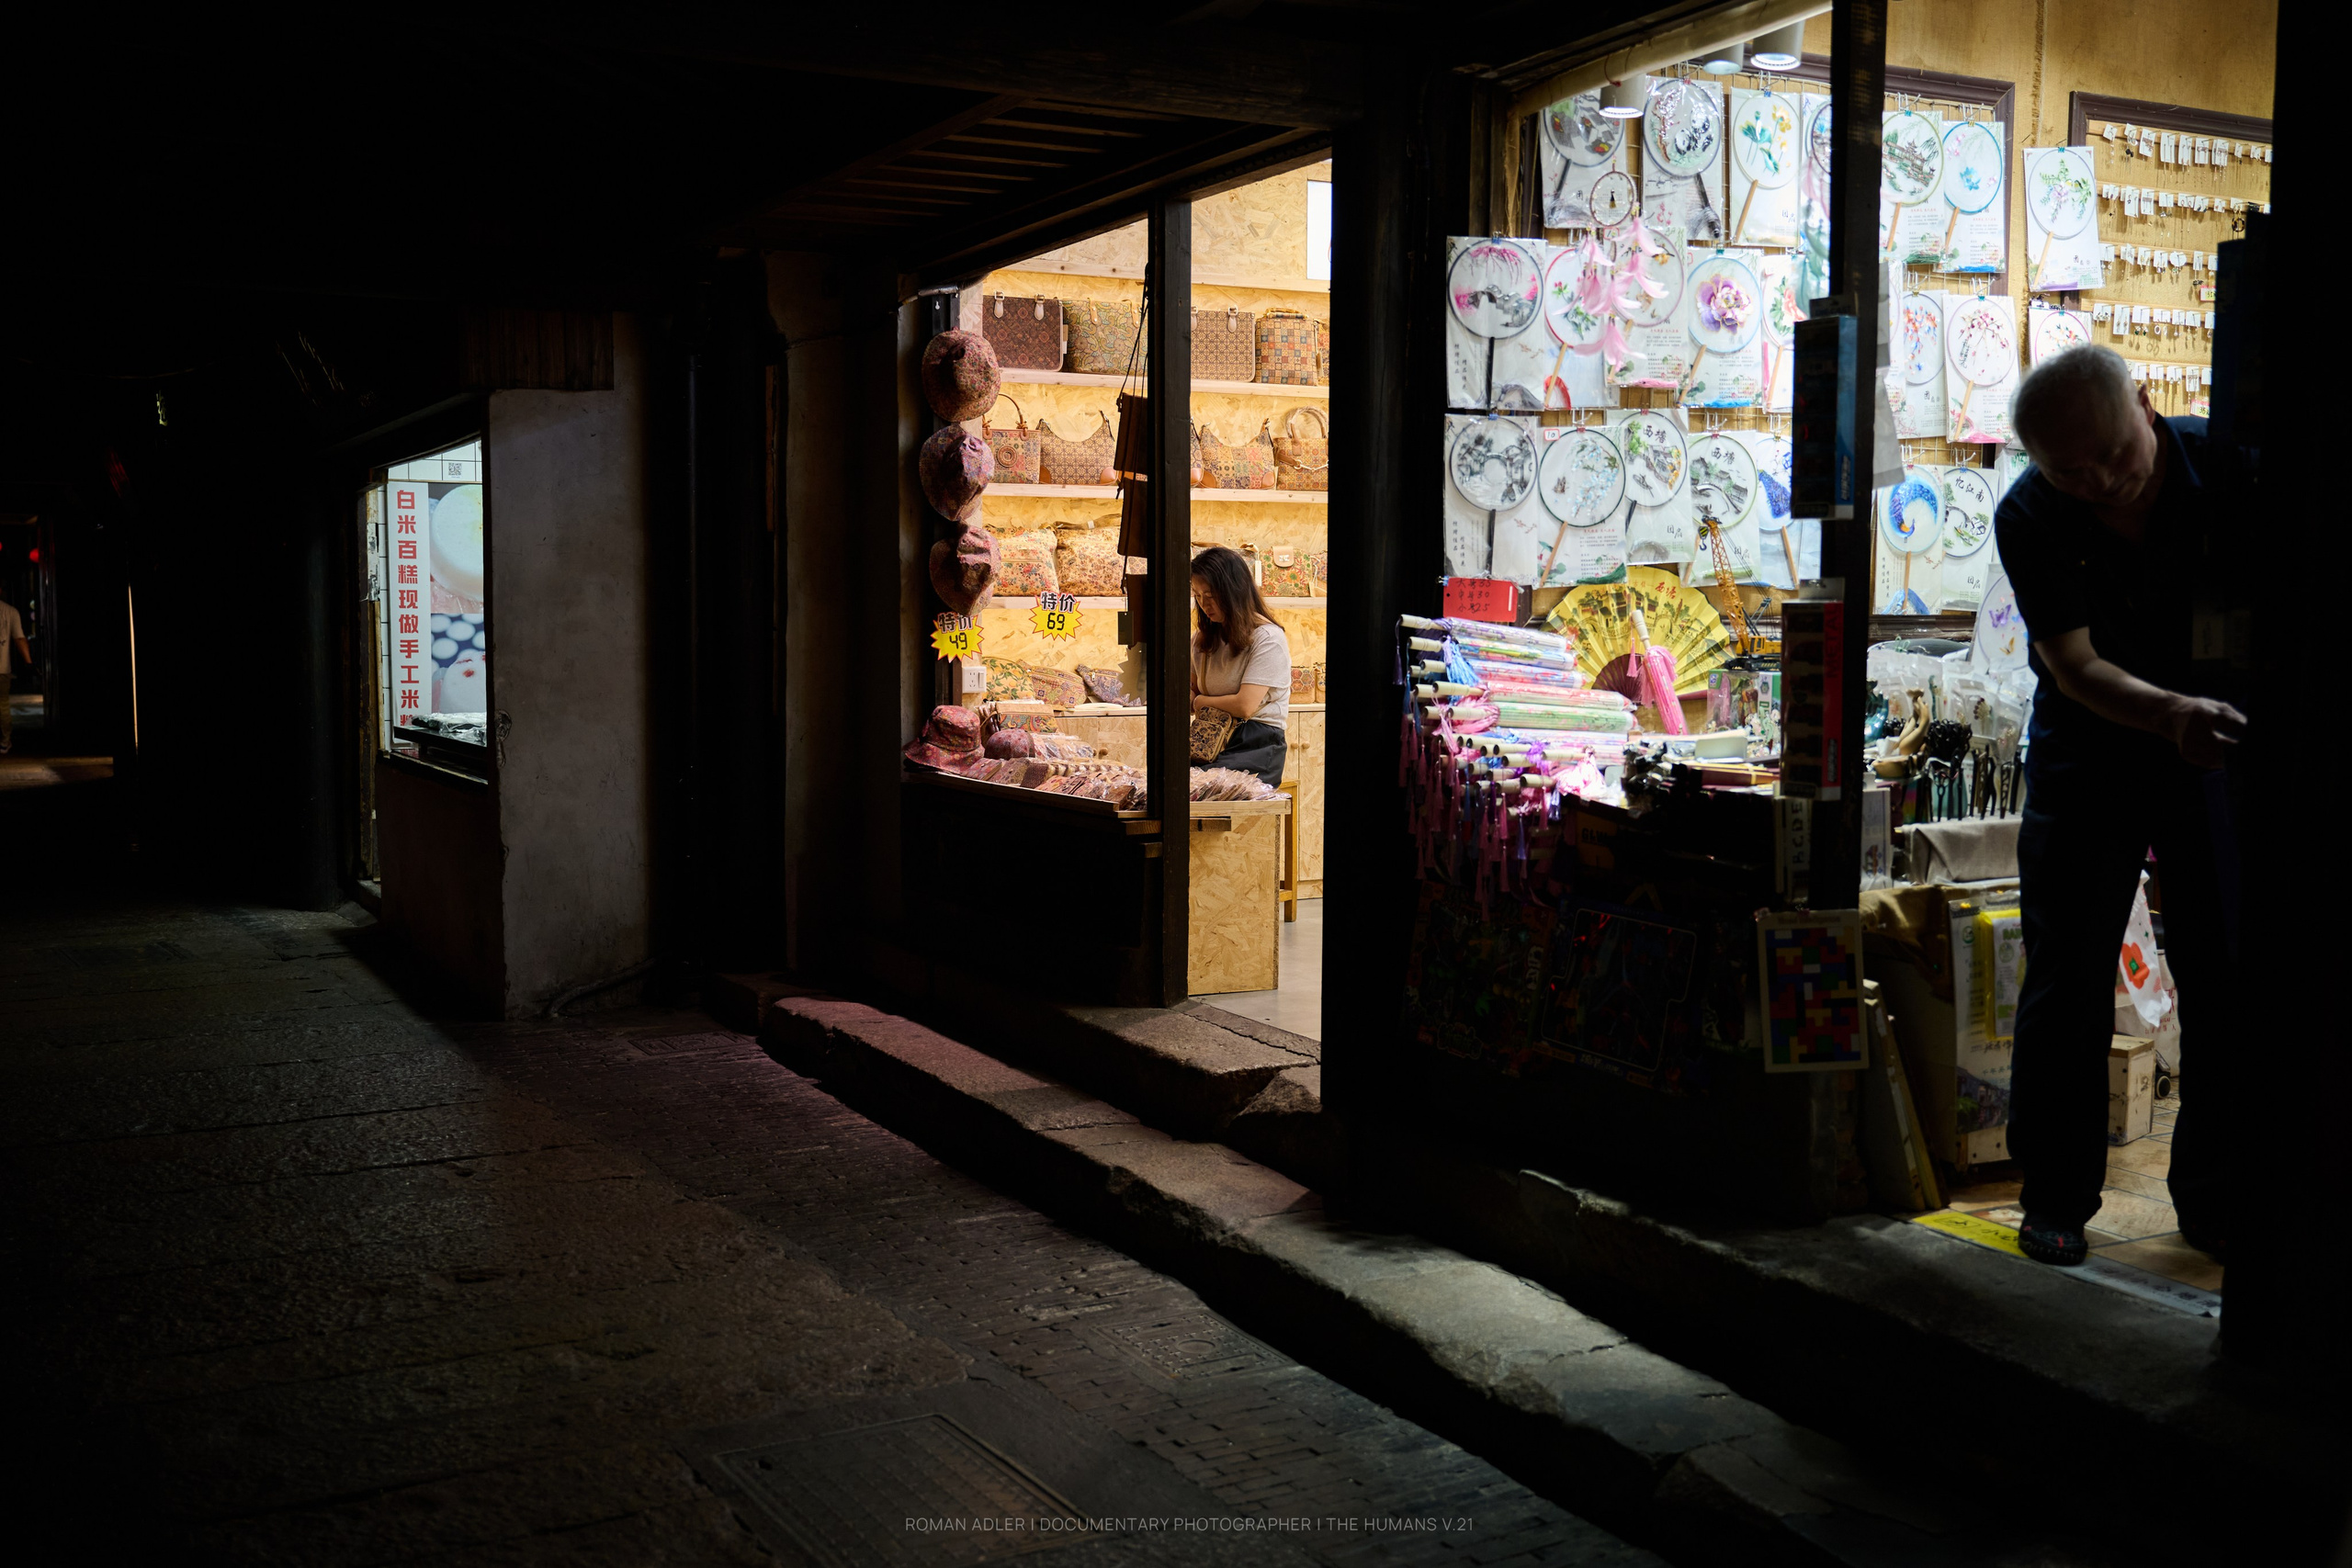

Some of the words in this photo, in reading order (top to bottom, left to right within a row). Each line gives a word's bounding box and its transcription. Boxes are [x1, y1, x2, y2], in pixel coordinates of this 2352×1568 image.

[1643, 424, 1667, 444] 西塘
[1711, 446, 1736, 466] 西塘
[1955, 475, 1985, 502] 忆江南
[1041, 592, 1075, 613] 特价
[1046, 613, 1065, 631] 69
[949, 632, 968, 650] 49
